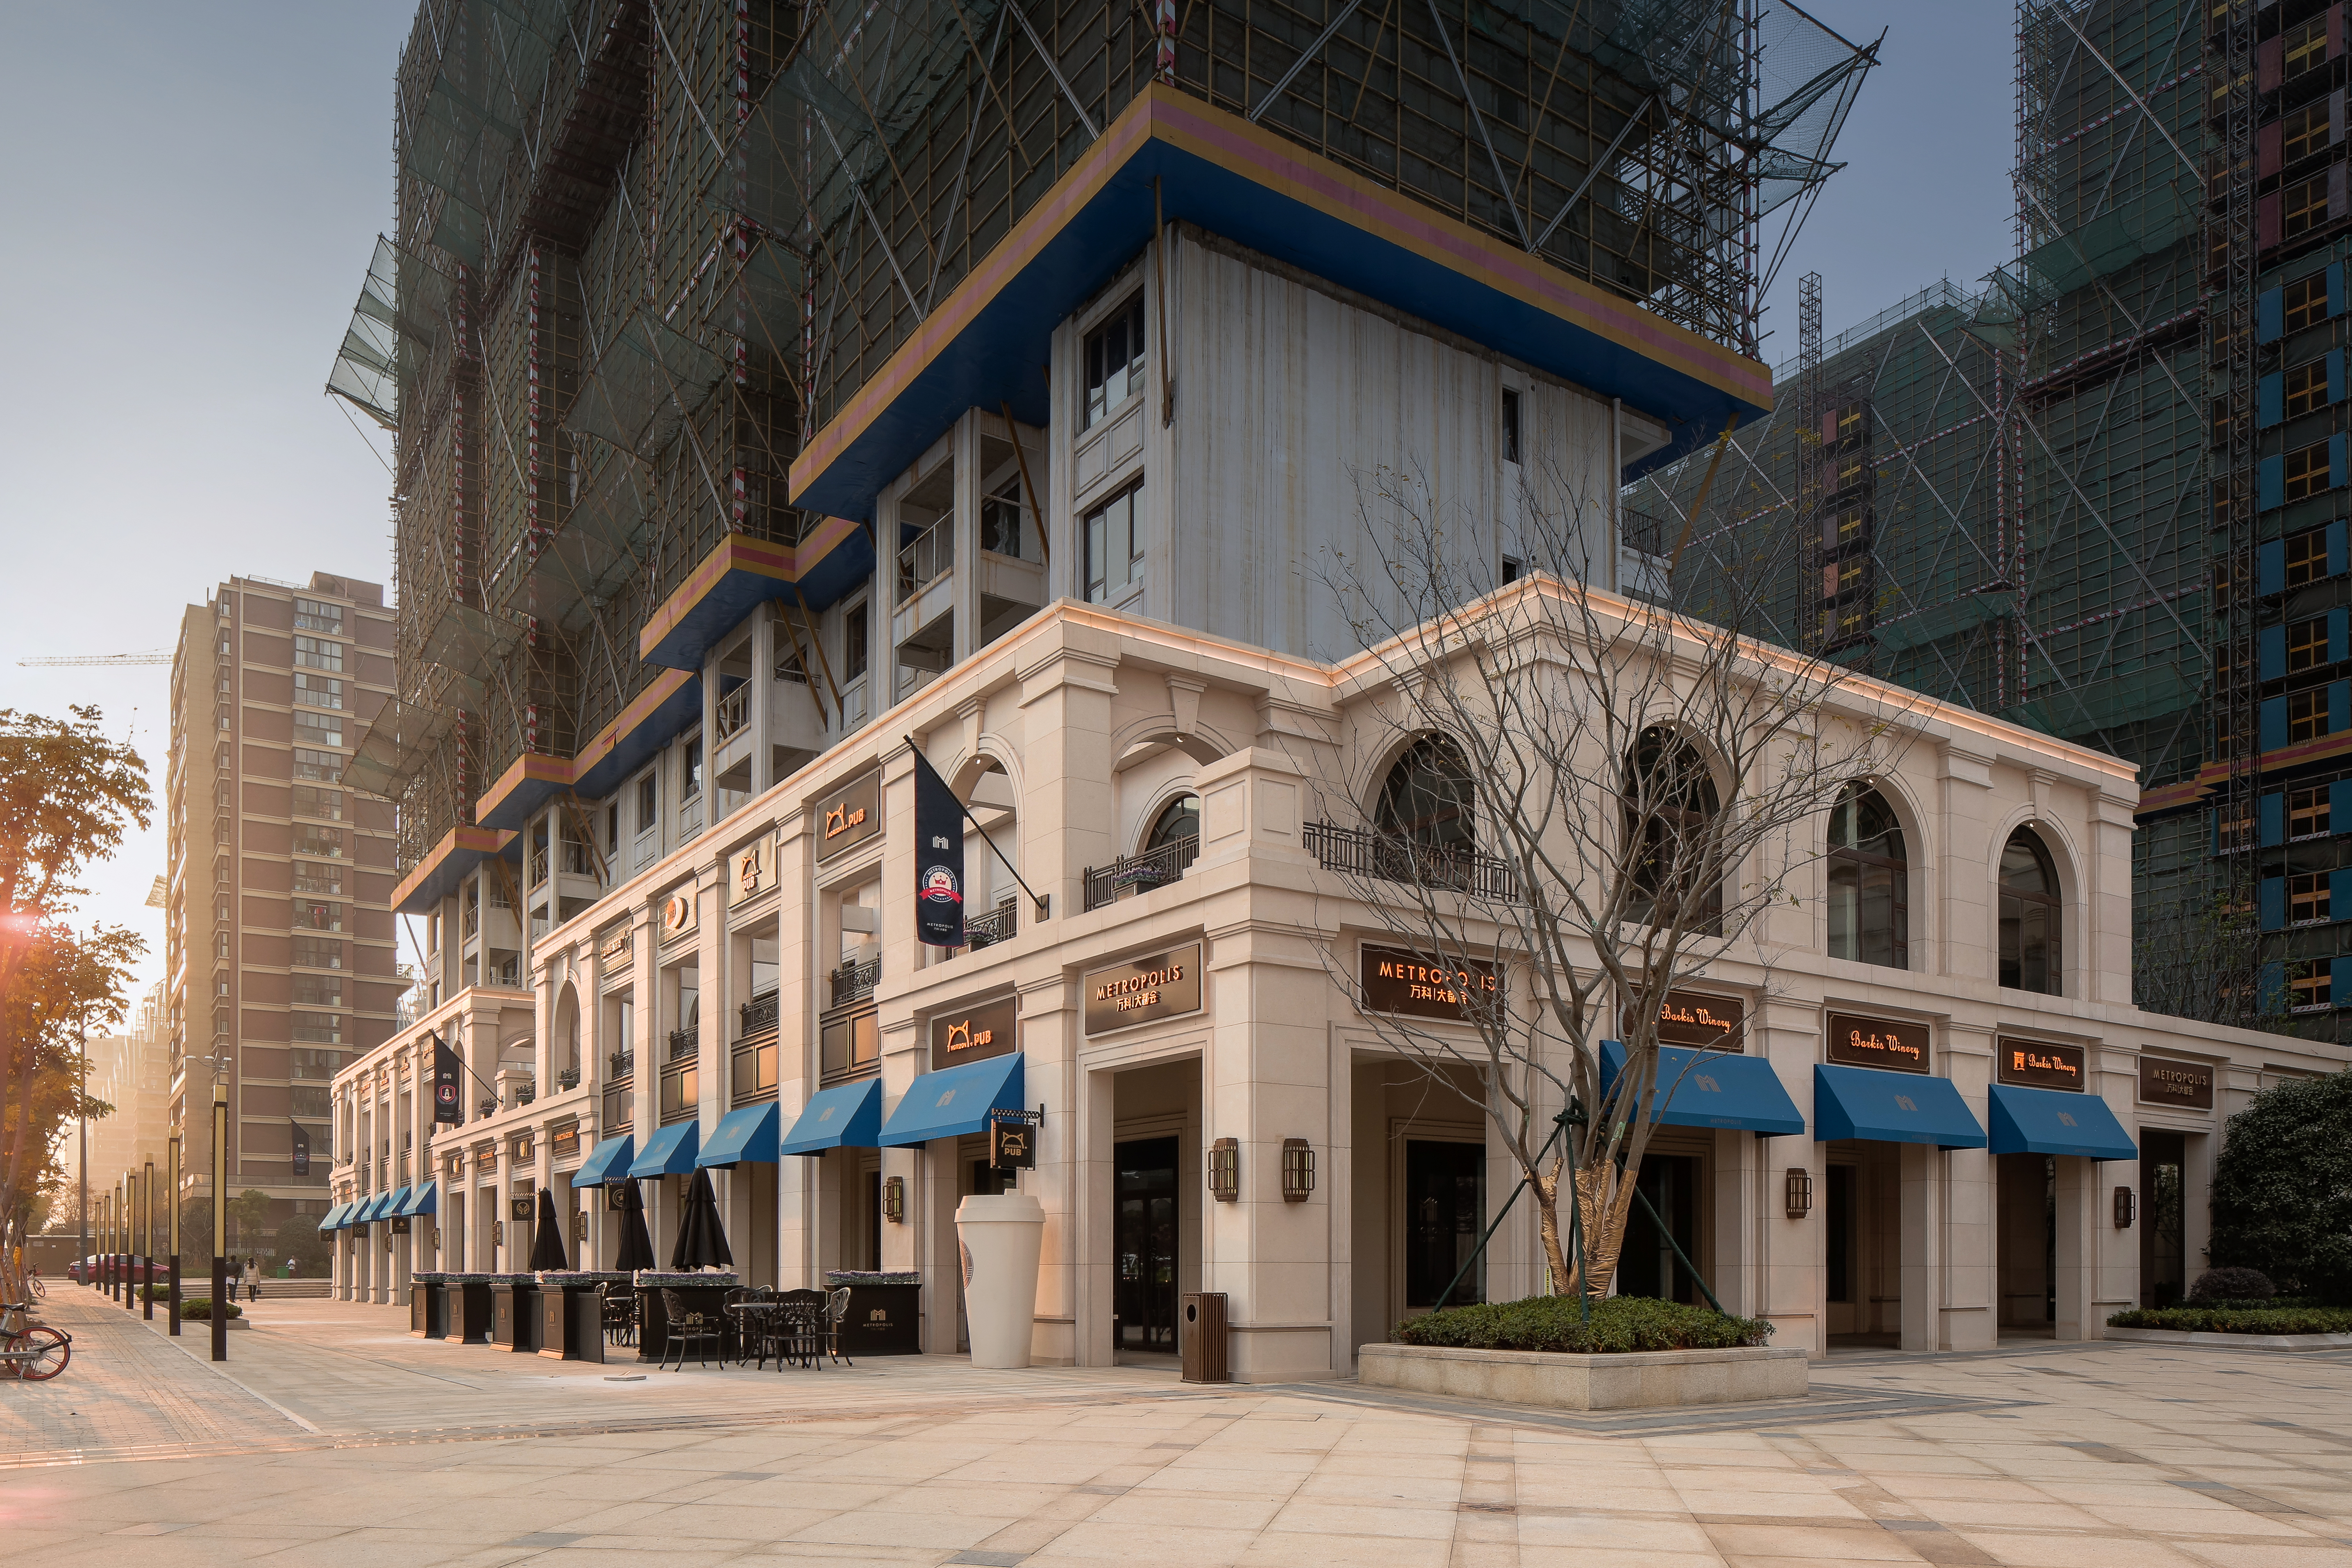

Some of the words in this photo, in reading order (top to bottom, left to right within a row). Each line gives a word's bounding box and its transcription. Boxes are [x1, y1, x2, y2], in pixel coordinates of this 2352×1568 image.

[848, 808, 864, 828] PUB
[927, 867, 954, 879] METROPOLIS
[743, 876, 755, 892] PUB
[1096, 964, 1181, 1001] METROPOLIS
[1661, 1004, 1695, 1023] Barkis
[1696, 1008, 1730, 1033] Winery
[974, 1030, 991, 1046] PUB
[1850, 1030, 1884, 1050] Barkis
[1886, 1034, 1920, 1060] Winery
[2029, 1053, 2052, 1069] Barkis
[2052, 1056, 2077, 1077] Winery
[2153, 1069, 2207, 1085] METROPOLIS
[1005, 1148, 1022, 1156] PUB
